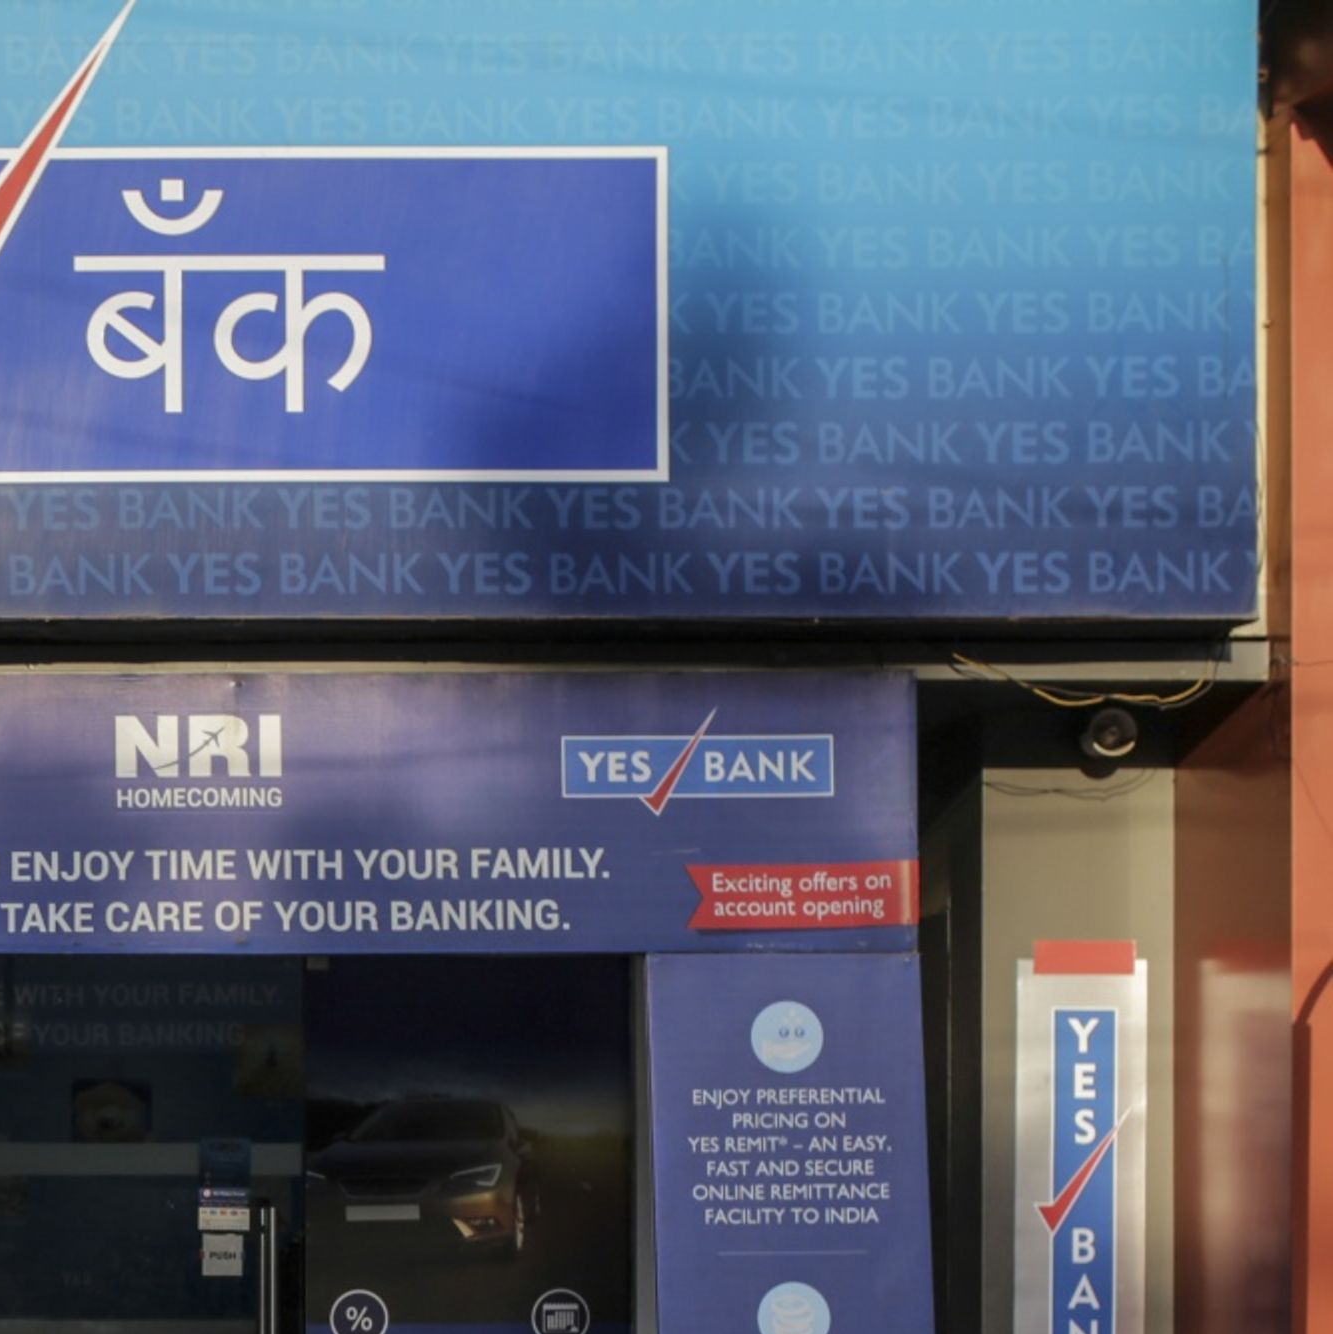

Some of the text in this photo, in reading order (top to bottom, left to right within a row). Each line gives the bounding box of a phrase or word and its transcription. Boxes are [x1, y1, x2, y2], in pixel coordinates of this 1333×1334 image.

[7, 486, 1178, 530] YES BANK YES BANK YES BANK YES BANK YES
[9, 554, 153, 597] BANK
[169, 554, 262, 596] YES
[280, 553, 425, 596] BANK
[438, 553, 532, 595] YES
[551, 552, 693, 595] BANK
[708, 552, 801, 595] YES
[819, 552, 963, 595] BANK
[976, 552, 1070, 594] YES
[1088, 551, 1230, 594] BANK
[115, 715, 282, 778] NRI
[578, 750, 817, 783] YES BANK
[116, 787, 282, 808] HOMECOMING
[11, 850, 135, 882] ENJOY
[145, 850, 236, 880] TIME
[247, 849, 342, 880] WITH
[354, 848, 459, 880] YOUR
[471, 848, 610, 879] FAMILY.
[712, 872, 891, 897] Exciting offers on
[0, 902, 95, 933] TAKE
[105, 901, 204, 932] CARE
[215, 901, 263, 931] OF
[274, 901, 378, 932] YOUR
[390, 899, 571, 931] BANKING.
[714, 895, 884, 920] account opening
[1068, 1018, 1100, 1145] YES
[692, 1088, 886, 1109] ENJOY PREFERENTIAL
[732, 1112, 846, 1129] PRICING ON
[688, 1137, 719, 1152] YES
[809, 1136, 837, 1152] AN
[843, 1135, 892, 1153] EASY,
[707, 1159, 874, 1176] FAST AND SECURE
[692, 1183, 890, 1201] ONLINE REMITTANCE
[705, 1207, 879, 1224] FACILITY TO INDIA
[209, 1252, 236, 1261] PUSH
